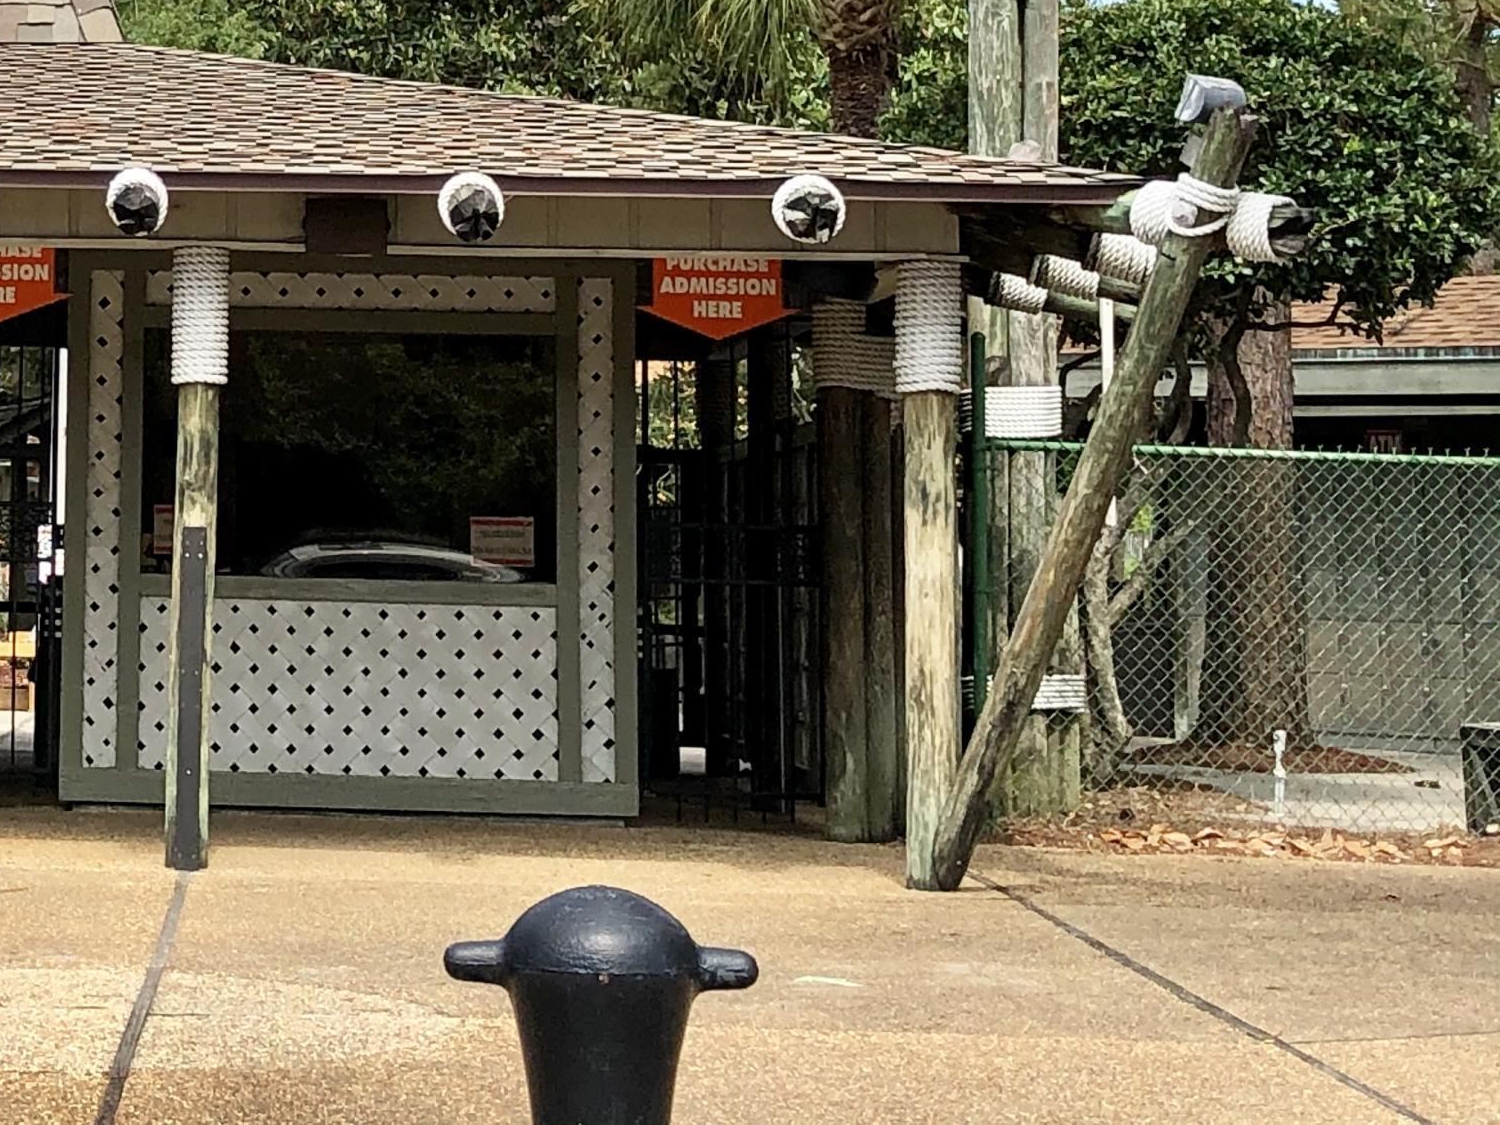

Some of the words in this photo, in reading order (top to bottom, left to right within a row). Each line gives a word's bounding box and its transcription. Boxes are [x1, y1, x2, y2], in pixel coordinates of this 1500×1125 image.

[666, 257, 769, 272] PURCHASE
[660, 276, 776, 295] ADMISSION
[693, 300, 742, 318] HERE
